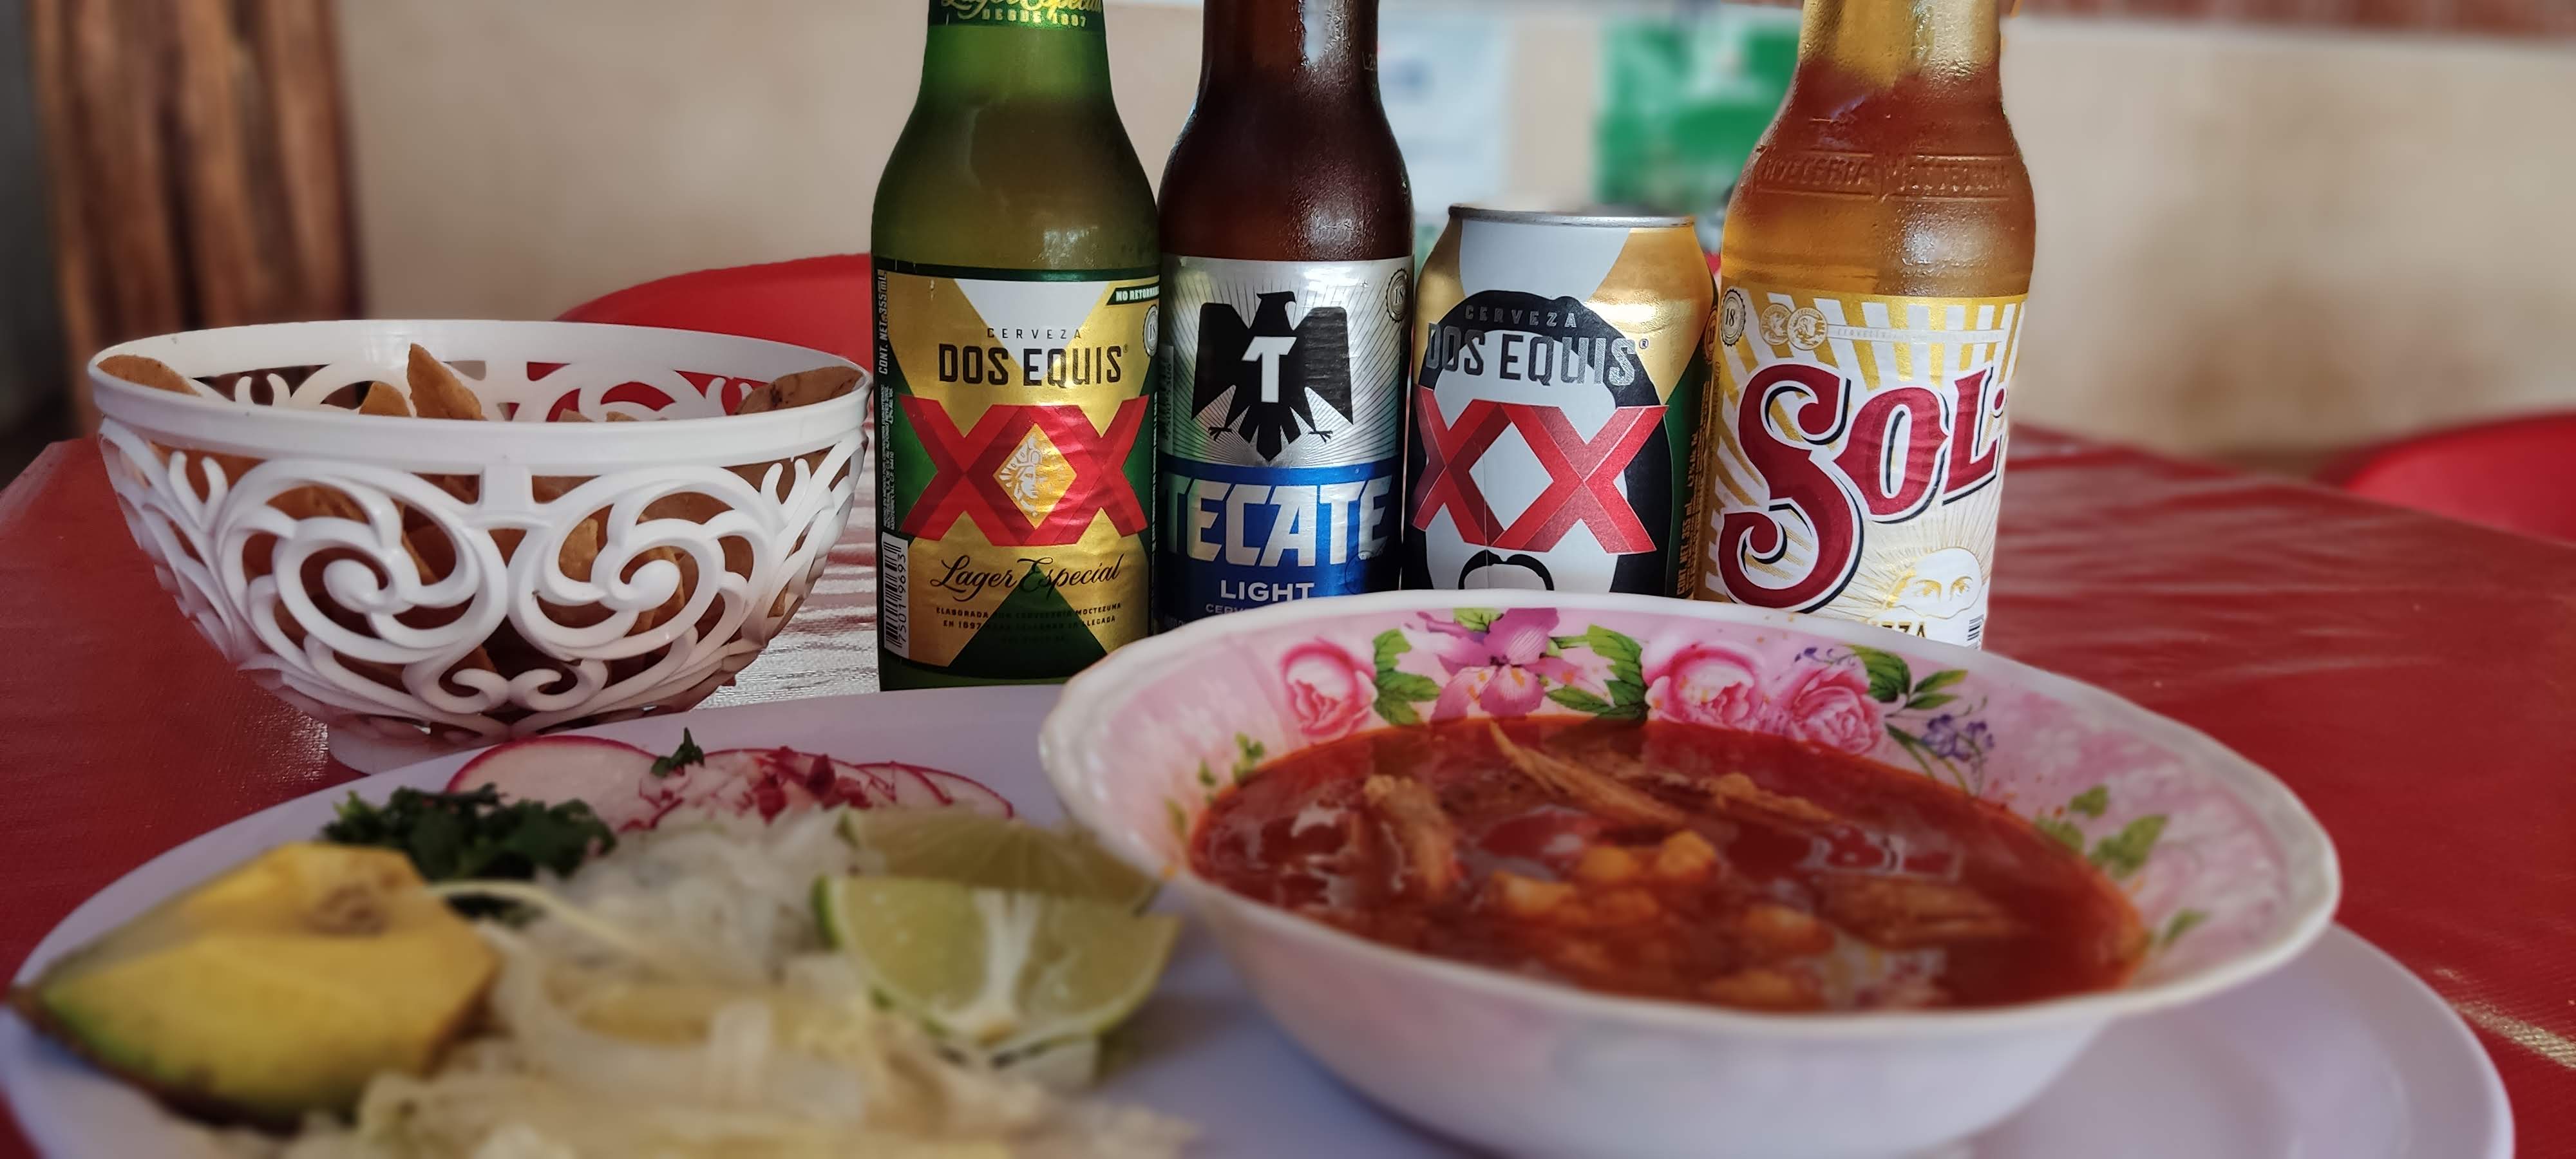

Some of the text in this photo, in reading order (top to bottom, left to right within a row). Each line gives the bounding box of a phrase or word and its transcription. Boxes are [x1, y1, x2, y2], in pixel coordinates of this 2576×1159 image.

[878, 293, 887, 315] 355
[1115, 290, 1128, 301] NO
[878, 318, 888, 341] NET.
[1464, 305, 1577, 329] CERVEZA
[1725, 307, 1736, 327] 18
[987, 327, 1081, 339] CERVEZA
[878, 344, 888, 375] CONT.
[938, 343, 1123, 388] DOS EQUIS
[1242, 335, 1297, 403] T
[1425, 322, 1637, 388] DOS EQUIS
[900, 393, 1151, 547] XX
[1412, 383, 1670, 555] XX
[1718, 363, 2002, 612] SOL
[1162, 471, 1393, 567] TECATE
[1681, 519, 1692, 540] 355
[929, 553, 1124, 602] Lager Especial
[1220, 580, 1315, 602] LIGHT
[1676, 565, 1688, 596] CONT.
[897, 553, 907, 643] 7501 9693
[936, 607, 989, 619] ELABORADA
[1075, 602, 1121, 616] MOCTEZUMA
[957, 621, 982, 630] 1897
